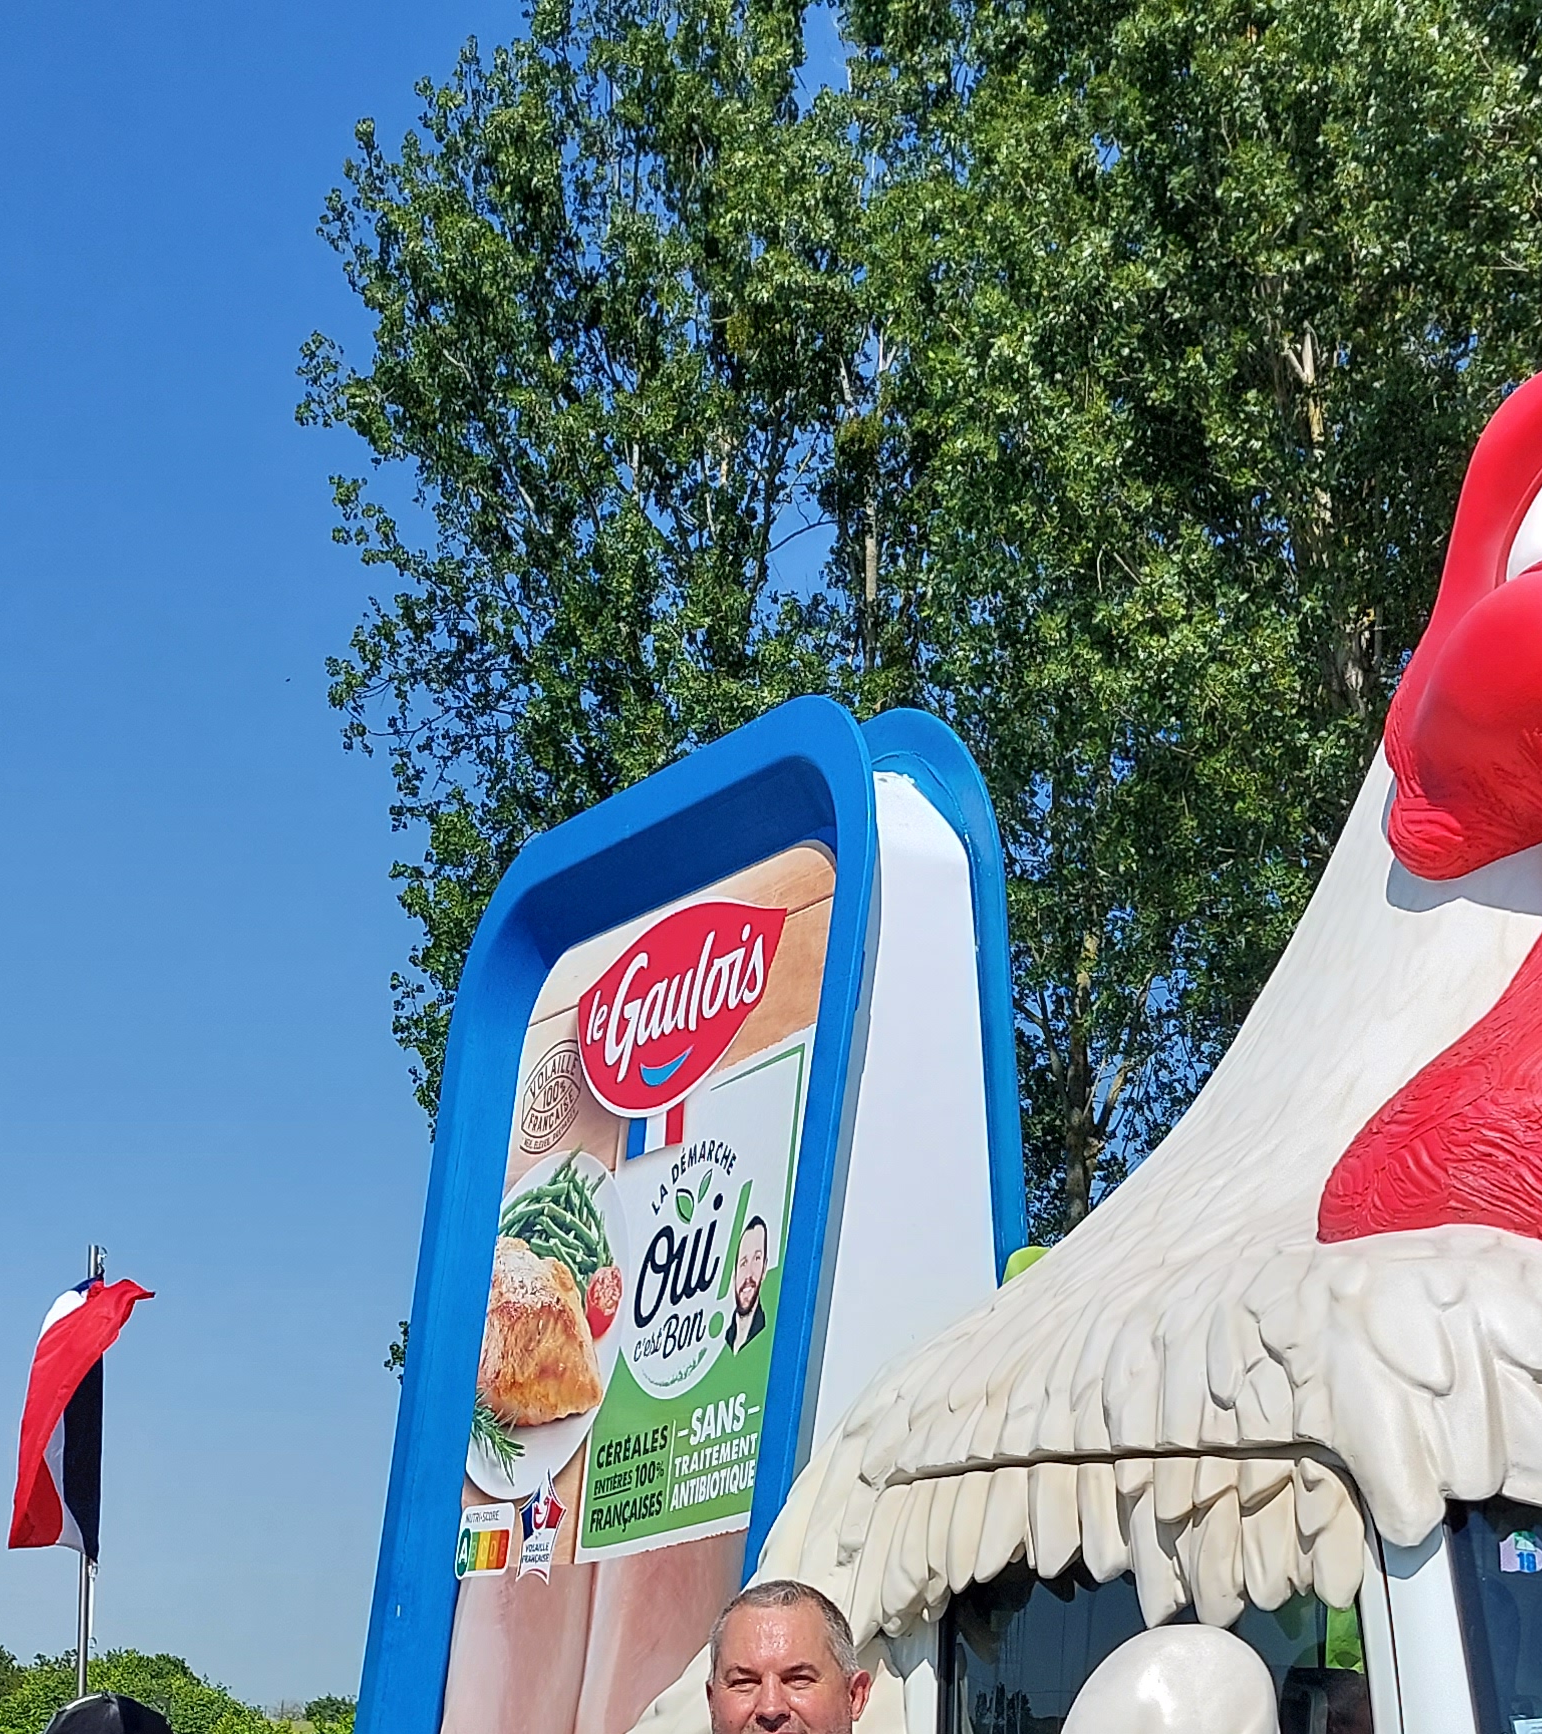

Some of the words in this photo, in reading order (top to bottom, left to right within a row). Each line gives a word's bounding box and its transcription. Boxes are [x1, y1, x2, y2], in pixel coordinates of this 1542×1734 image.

[586, 989, 608, 1046] le
[604, 923, 765, 1083] Gaulois
[529, 1054, 578, 1099] VOLAILLE
[542, 1080, 566, 1109] 100%
[651, 1183, 668, 1216] LA
[671, 1139, 737, 1185] DÉMARCHE
[662, 1308, 707, 1359] Bon
[689, 1392, 746, 1446] SANS
[596, 1424, 669, 1470] CÉRÉALES
[674, 1432, 758, 1478] TRAITEMENT
[593, 1469, 633, 1496] ENTIÈRES
[634, 1460, 665, 1488] 100%
[669, 1458, 756, 1513] ANTIBIOTIQUE
[465, 1510, 500, 1523] NUTRI-SCORE
[589, 1490, 663, 1533] FRANÇAISES
[458, 1537, 468, 1565] A
